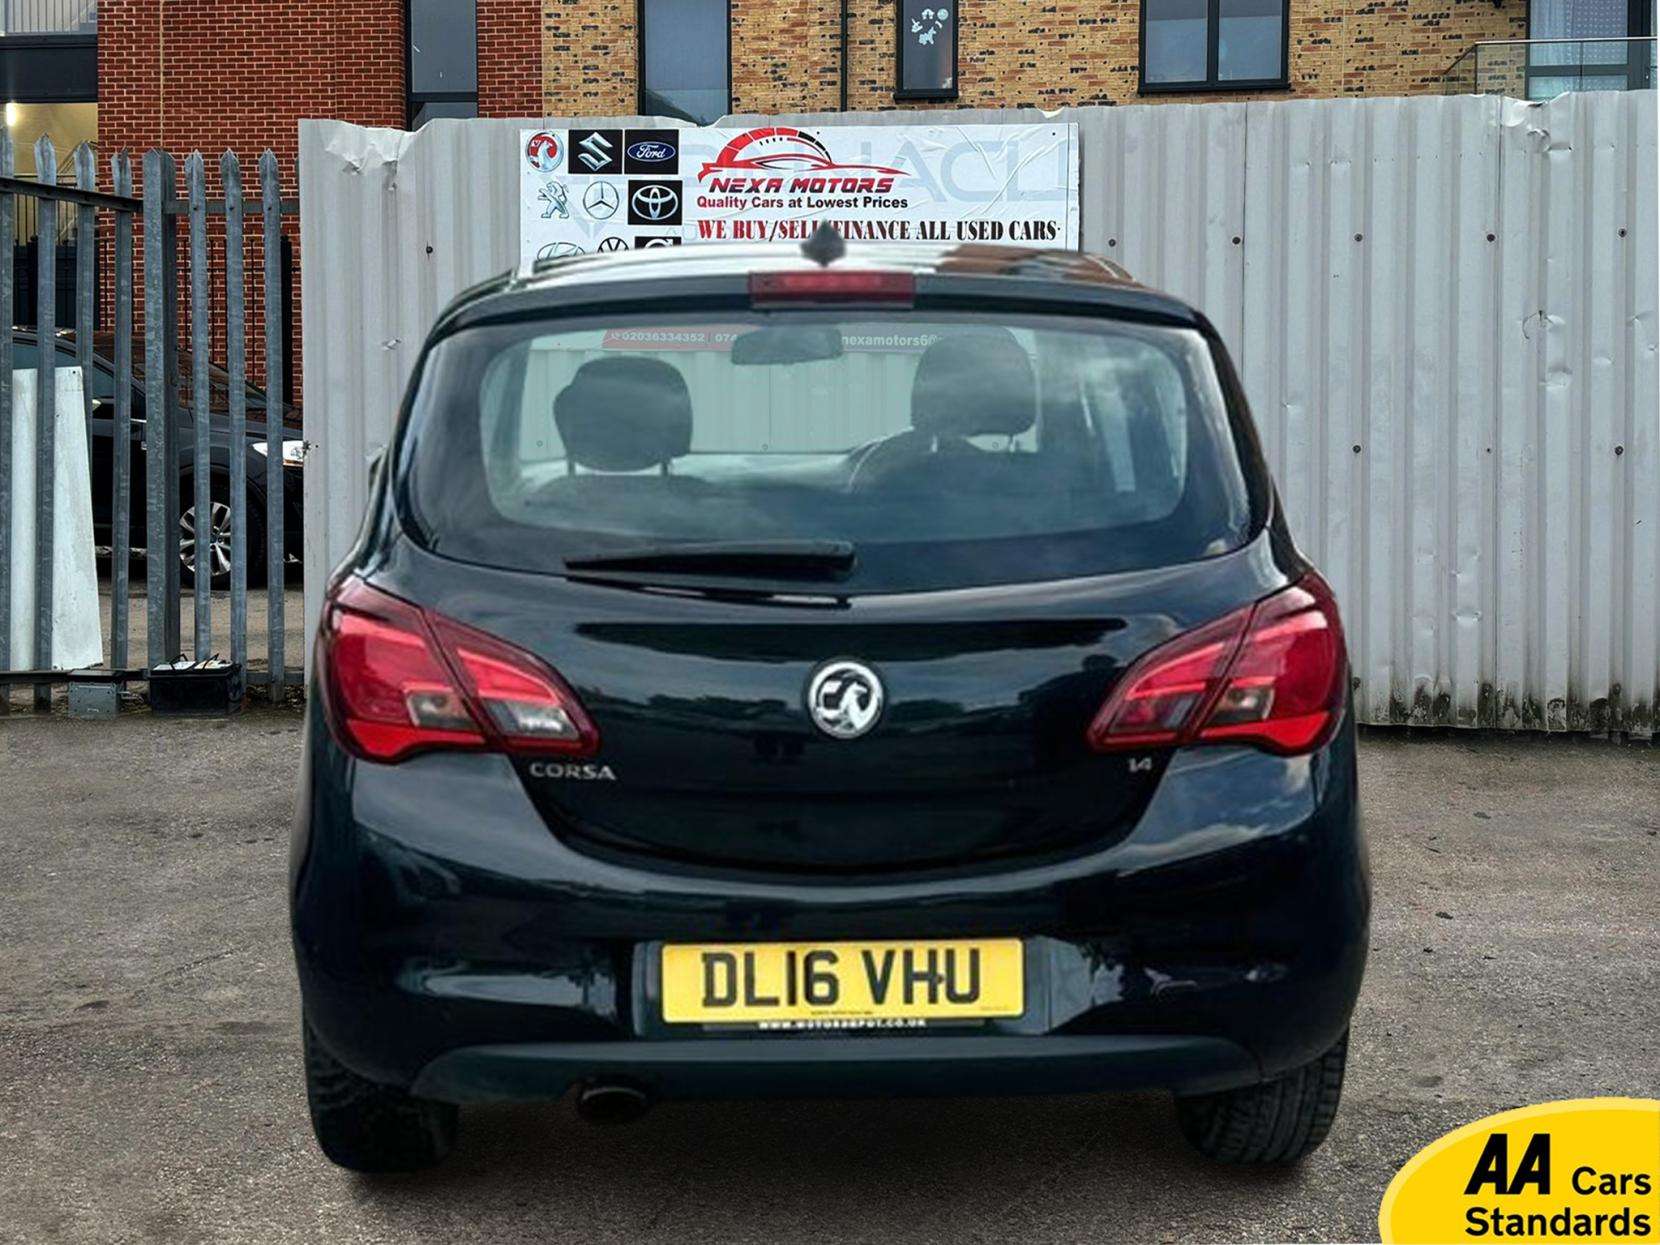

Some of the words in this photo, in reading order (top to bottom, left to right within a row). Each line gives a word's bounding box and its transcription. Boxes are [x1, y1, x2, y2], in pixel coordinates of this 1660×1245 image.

[636, 144, 665, 159] Ford
[709, 177, 783, 194] NEXA
[789, 177, 895, 194] MOTORS
[697, 195, 747, 210] Quality
[751, 196, 783, 208] Cars
[788, 196, 803, 208] at
[807, 196, 859, 208] Lowest
[863, 195, 908, 208] Prices
[698, 220, 727, 240] WE
[915, 220, 951, 240] ALL
[956, 219, 1004, 240] USED
[1008, 219, 1057, 240] CARS
[529, 762, 616, 780] CORSA
[702, 950, 840, 1008] DL16
[861, 947, 980, 1006] VHU
